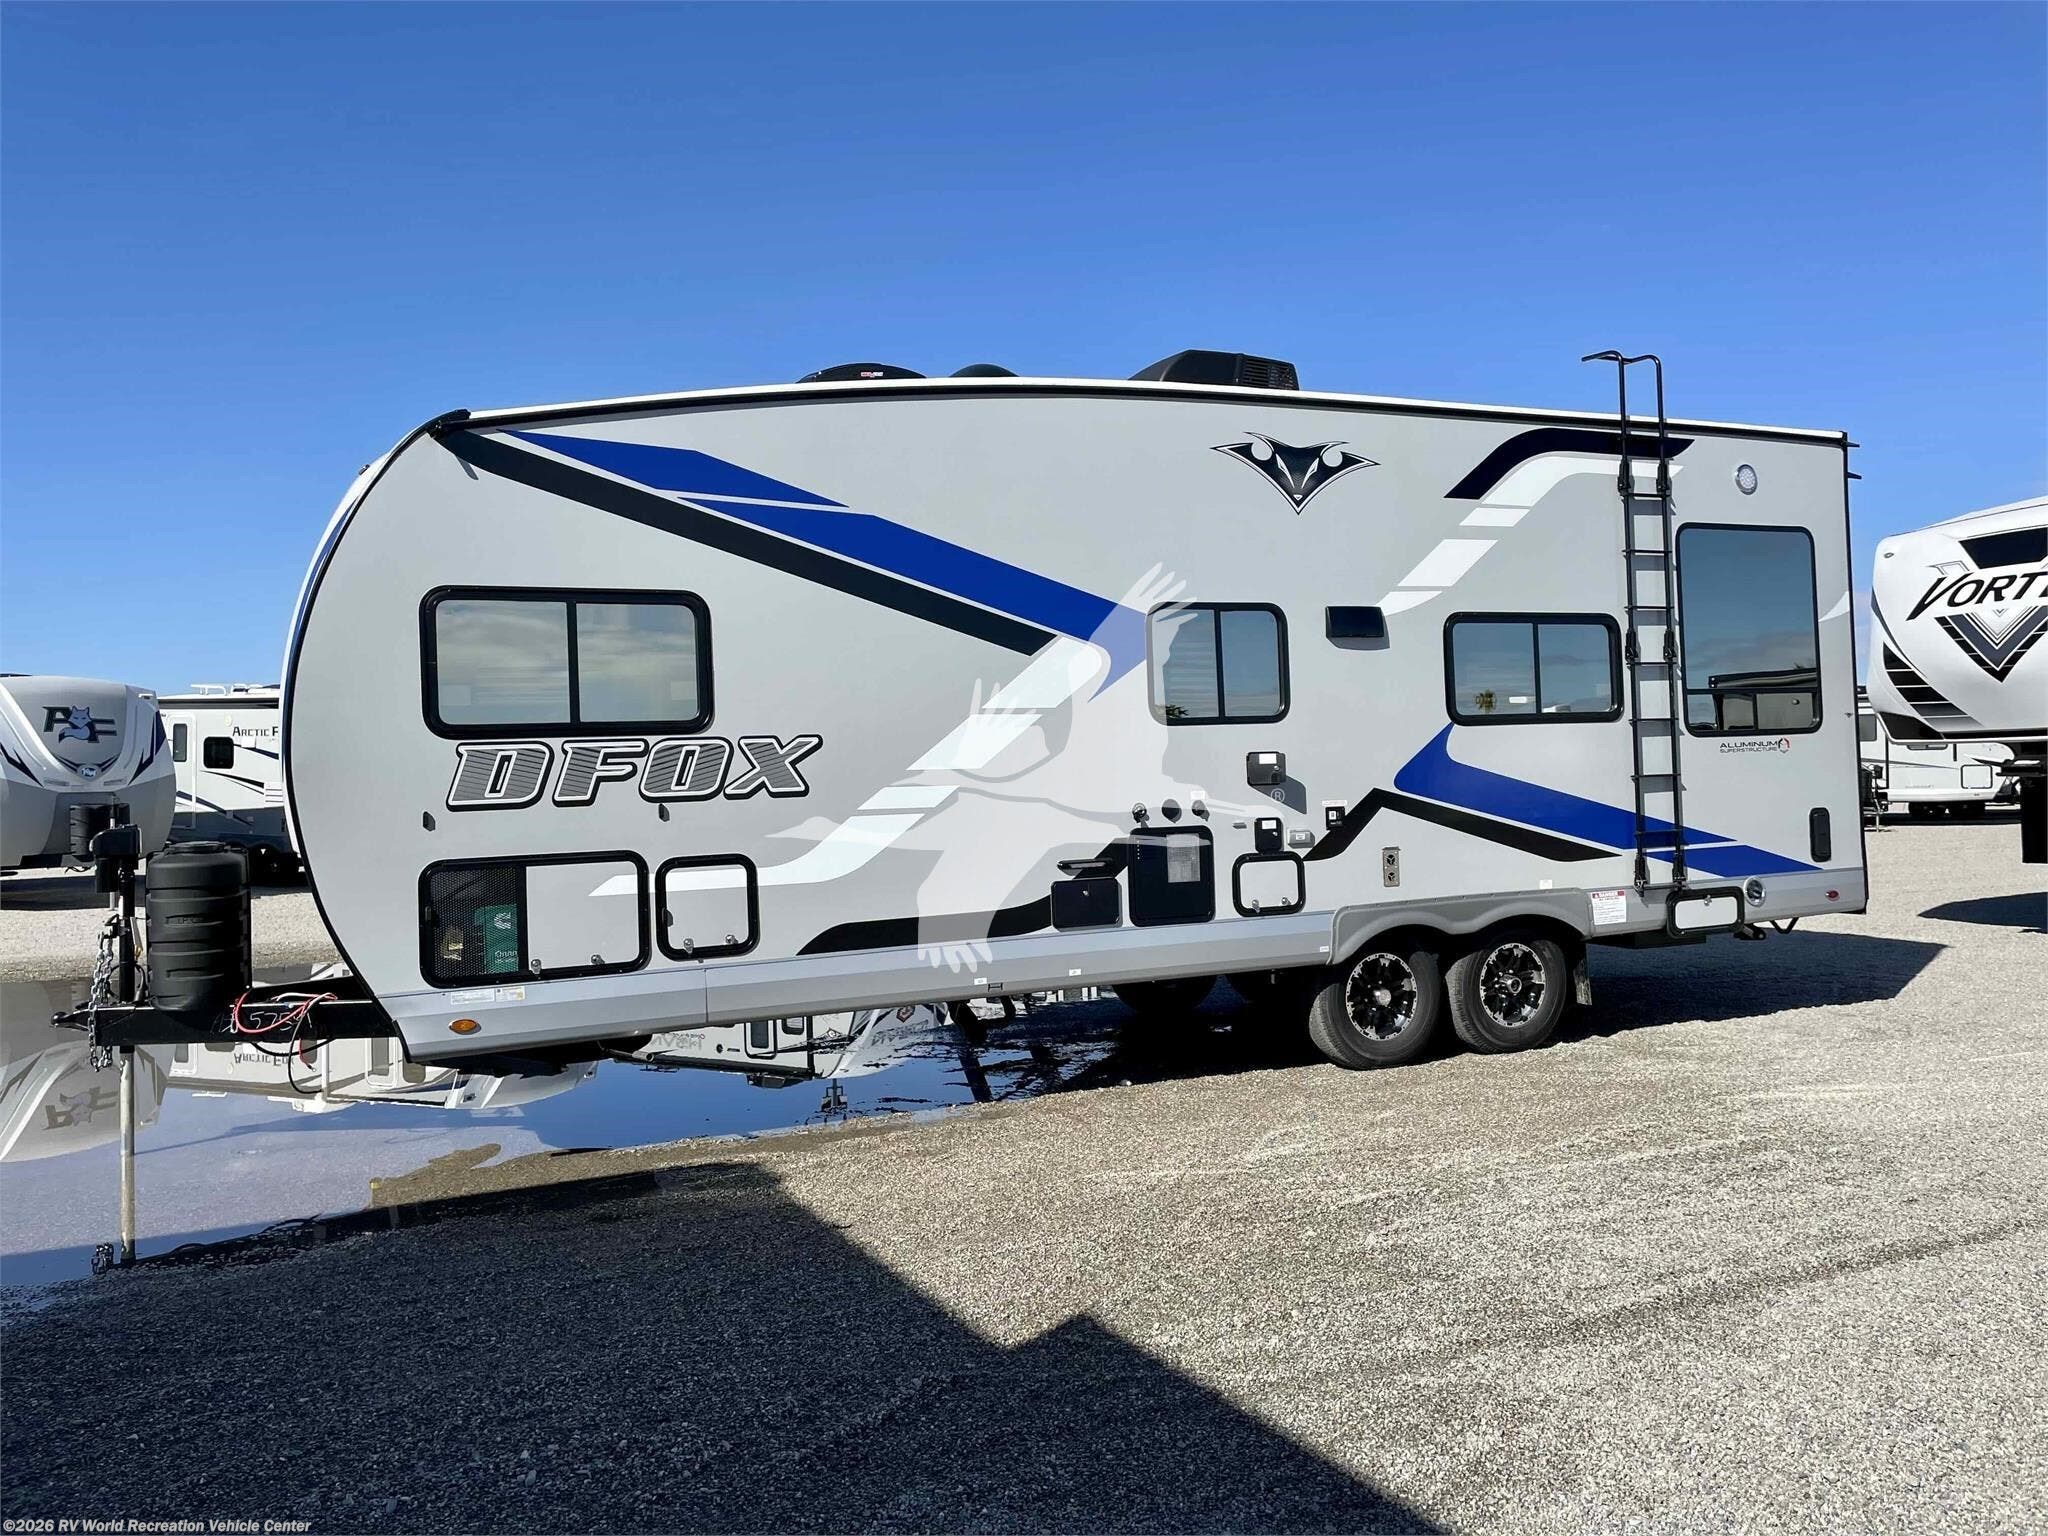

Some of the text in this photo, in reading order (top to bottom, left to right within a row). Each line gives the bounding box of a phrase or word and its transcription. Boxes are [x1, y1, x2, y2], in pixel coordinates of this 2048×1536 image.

[1719, 741, 1778, 749] ALUMINUM
[1719, 746, 1778, 754] SUPERSTRUCTURE
[446, 734, 823, 812] DFOX
